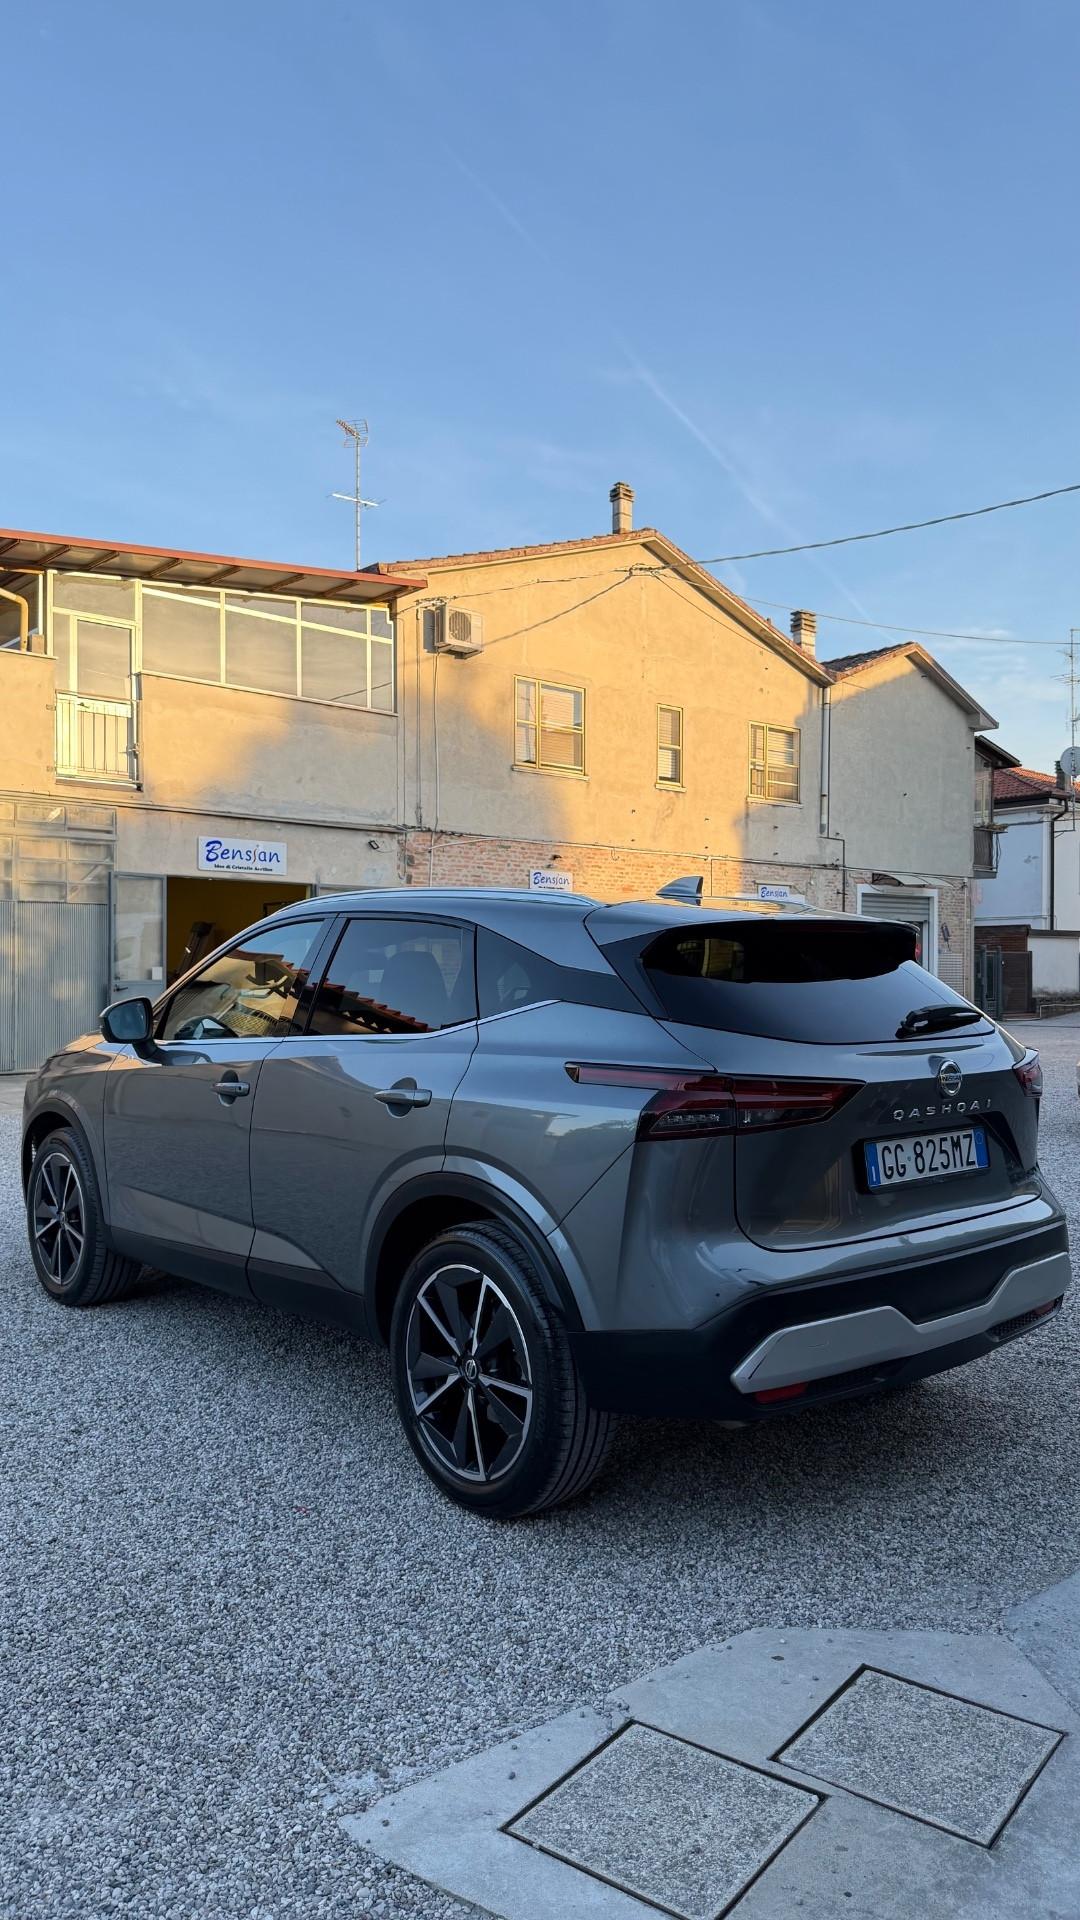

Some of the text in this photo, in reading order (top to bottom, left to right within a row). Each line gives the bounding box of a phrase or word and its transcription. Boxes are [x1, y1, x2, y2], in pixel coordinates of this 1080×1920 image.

[205, 840, 280, 864] Bensian
[533, 872, 570, 885] Bensian
[893, 1099, 991, 1121] QASHQAI
[881, 1133, 976, 1180] GG 825MZ
